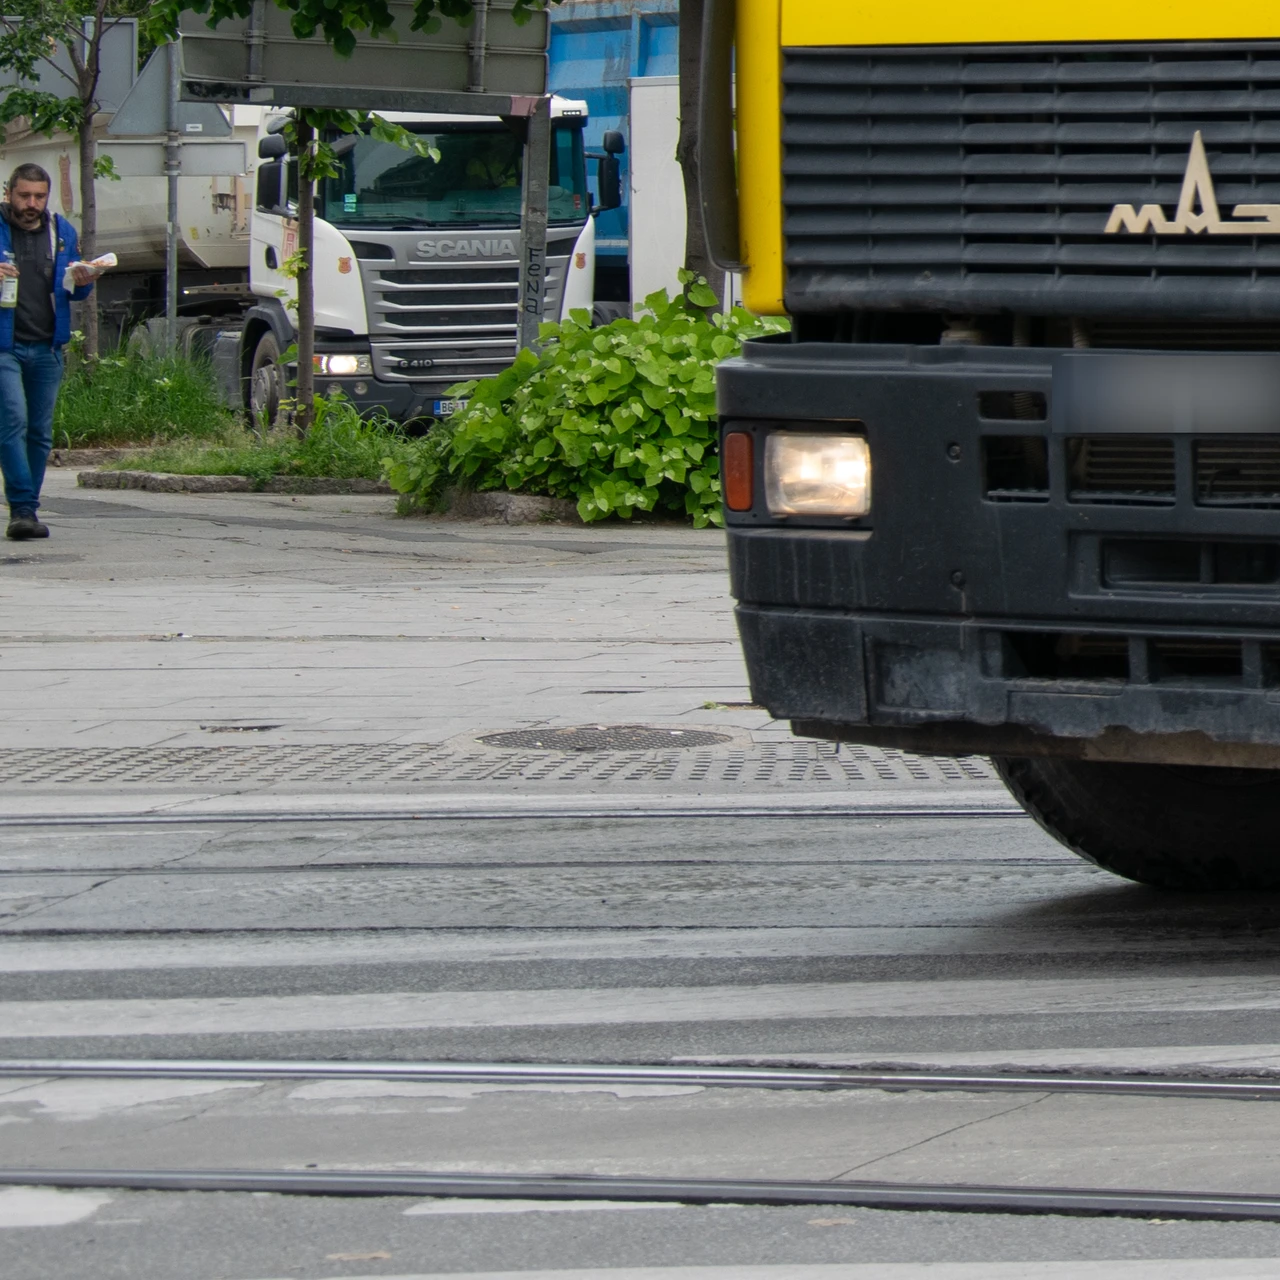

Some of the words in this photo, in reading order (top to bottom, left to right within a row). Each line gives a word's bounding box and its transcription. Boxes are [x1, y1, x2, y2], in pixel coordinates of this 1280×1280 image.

[416, 239, 517, 258] SCANIA
[400, 359, 409, 368] G
[410, 359, 432, 368] 410
[442, 402, 453, 413] BG
